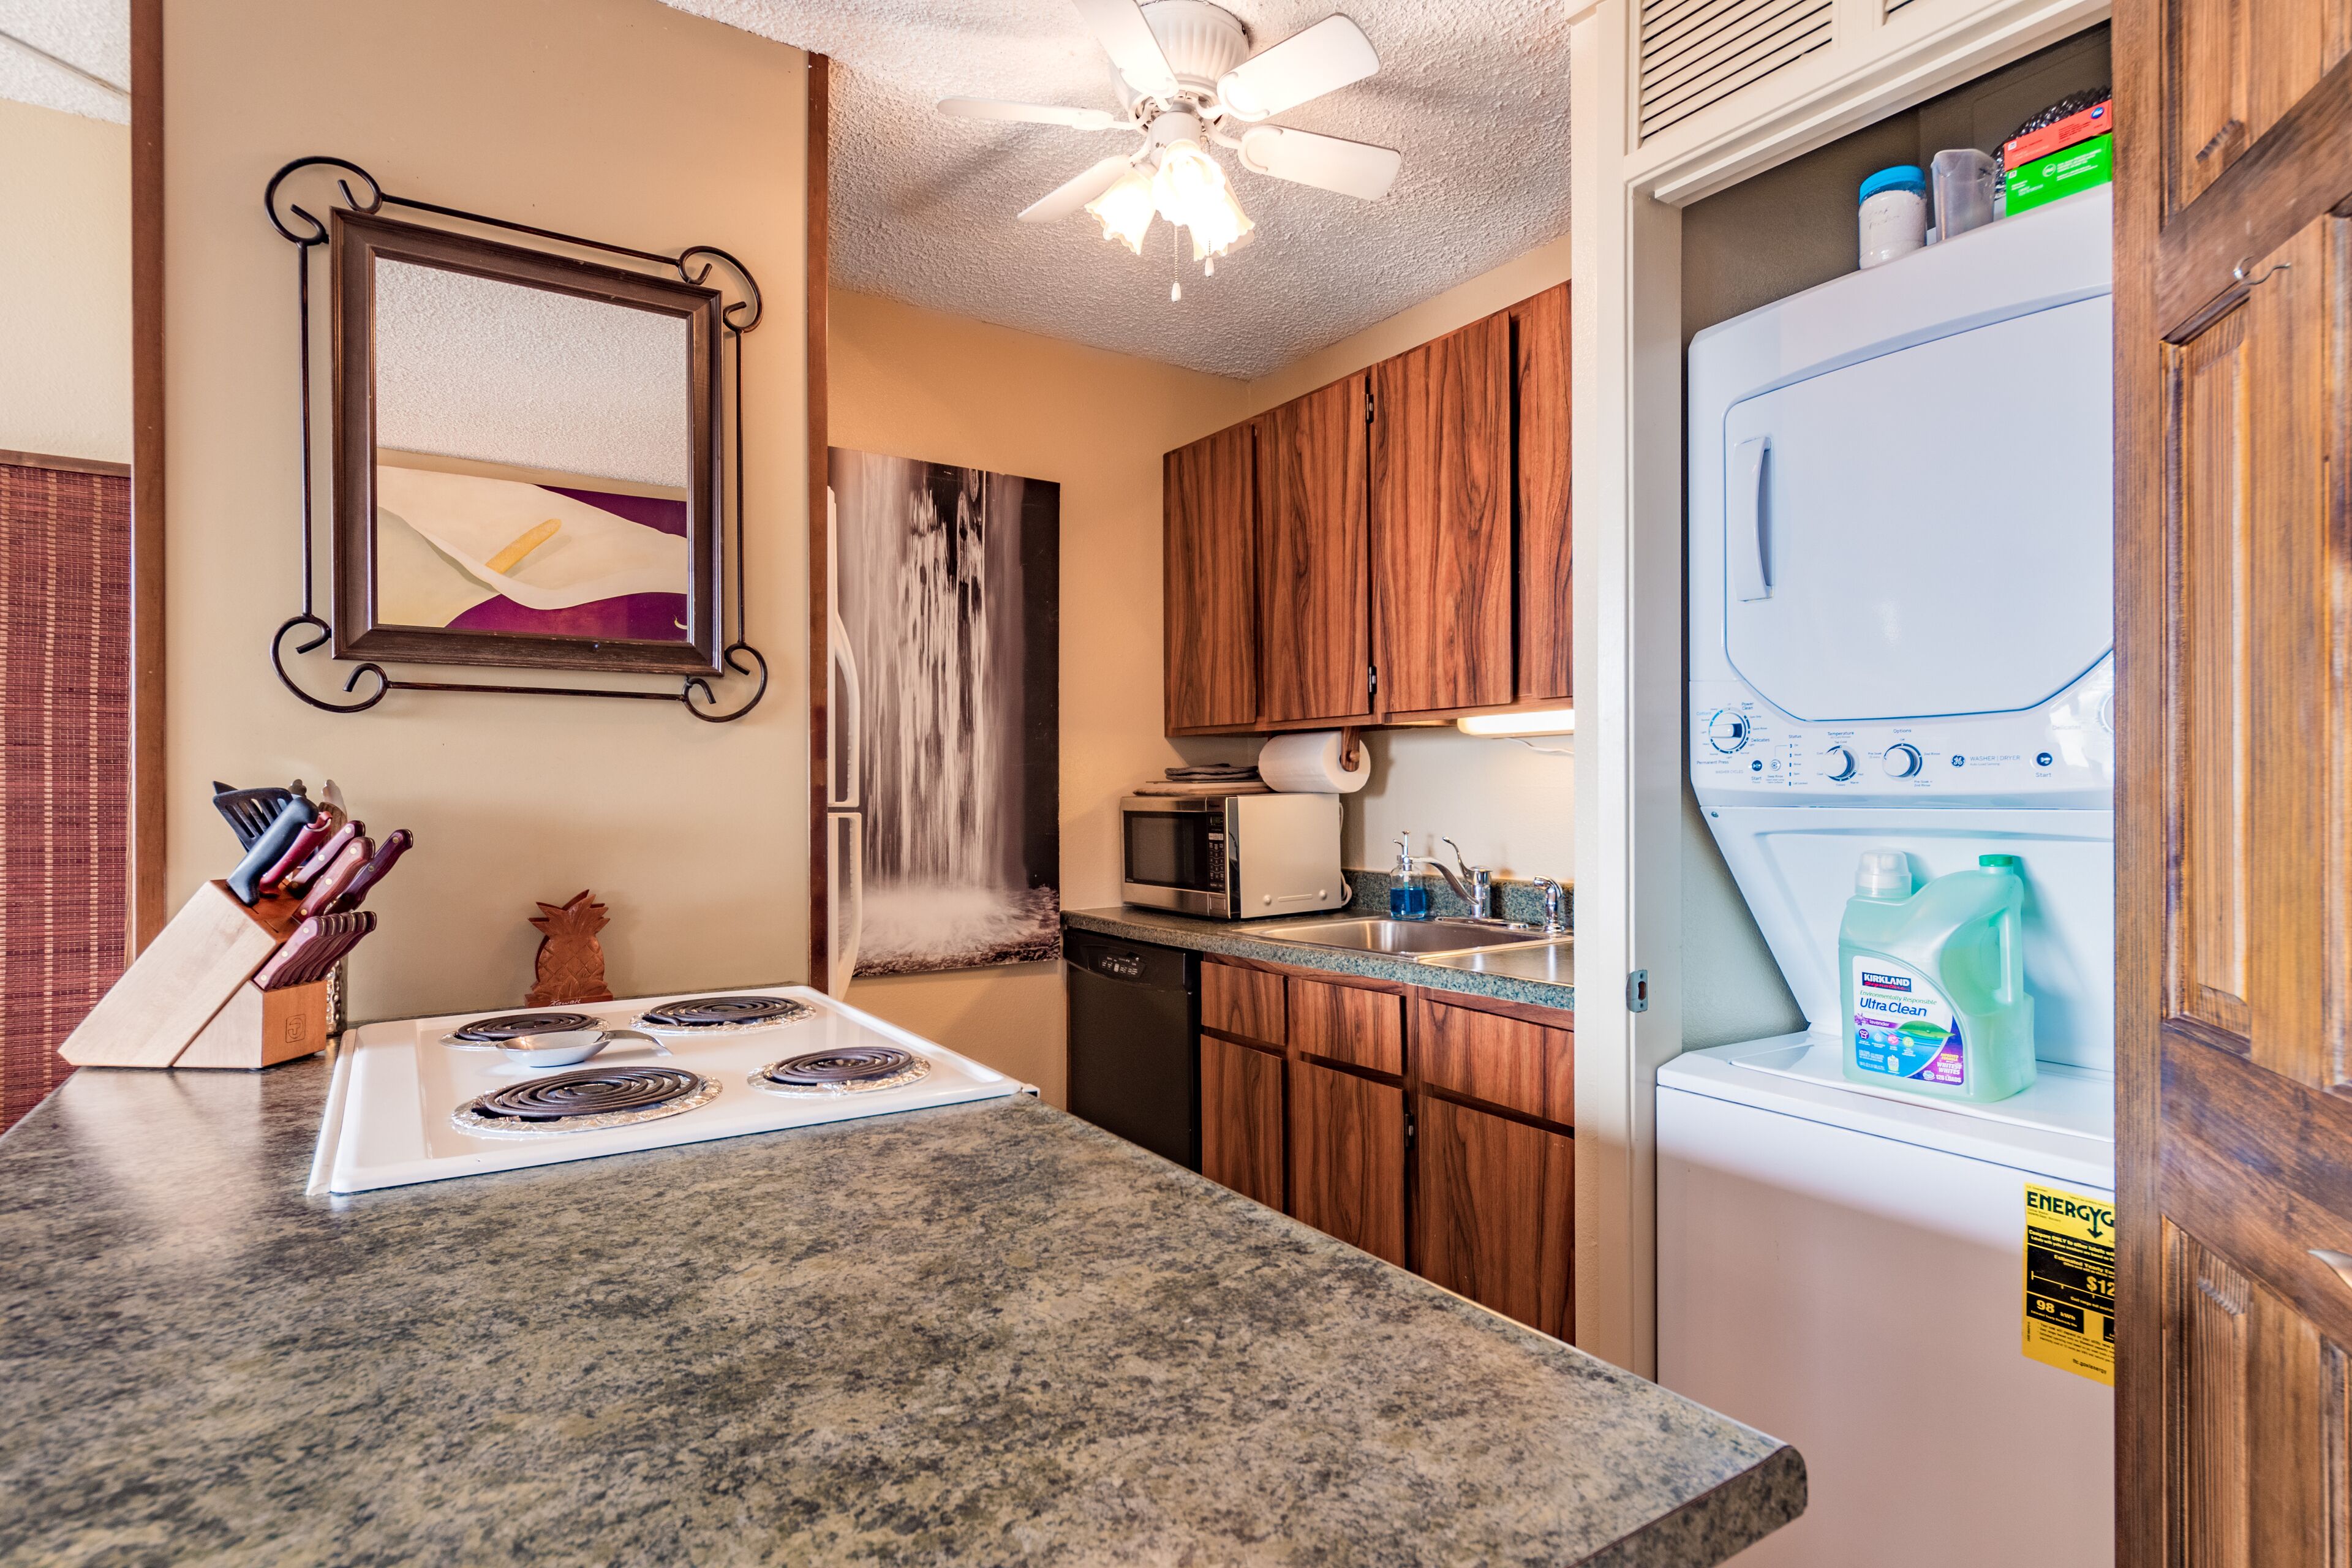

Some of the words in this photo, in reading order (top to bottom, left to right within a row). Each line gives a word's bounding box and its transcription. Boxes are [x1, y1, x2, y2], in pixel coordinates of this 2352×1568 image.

[1864, 974, 1910, 987] KIRKLAND
[1860, 990, 1902, 1001] Environmentally
[1860, 997, 1887, 1011] Ultra
[1888, 1002, 1927, 1017] Clean
[2029, 1229, 2051, 1239] Compare
[2054, 1254, 2082, 1266] Estimated
[2084, 1263, 2103, 1272] Yearly
[2037, 1299, 2055, 1313] 98
[2060, 1311, 2076, 1321] kWh
